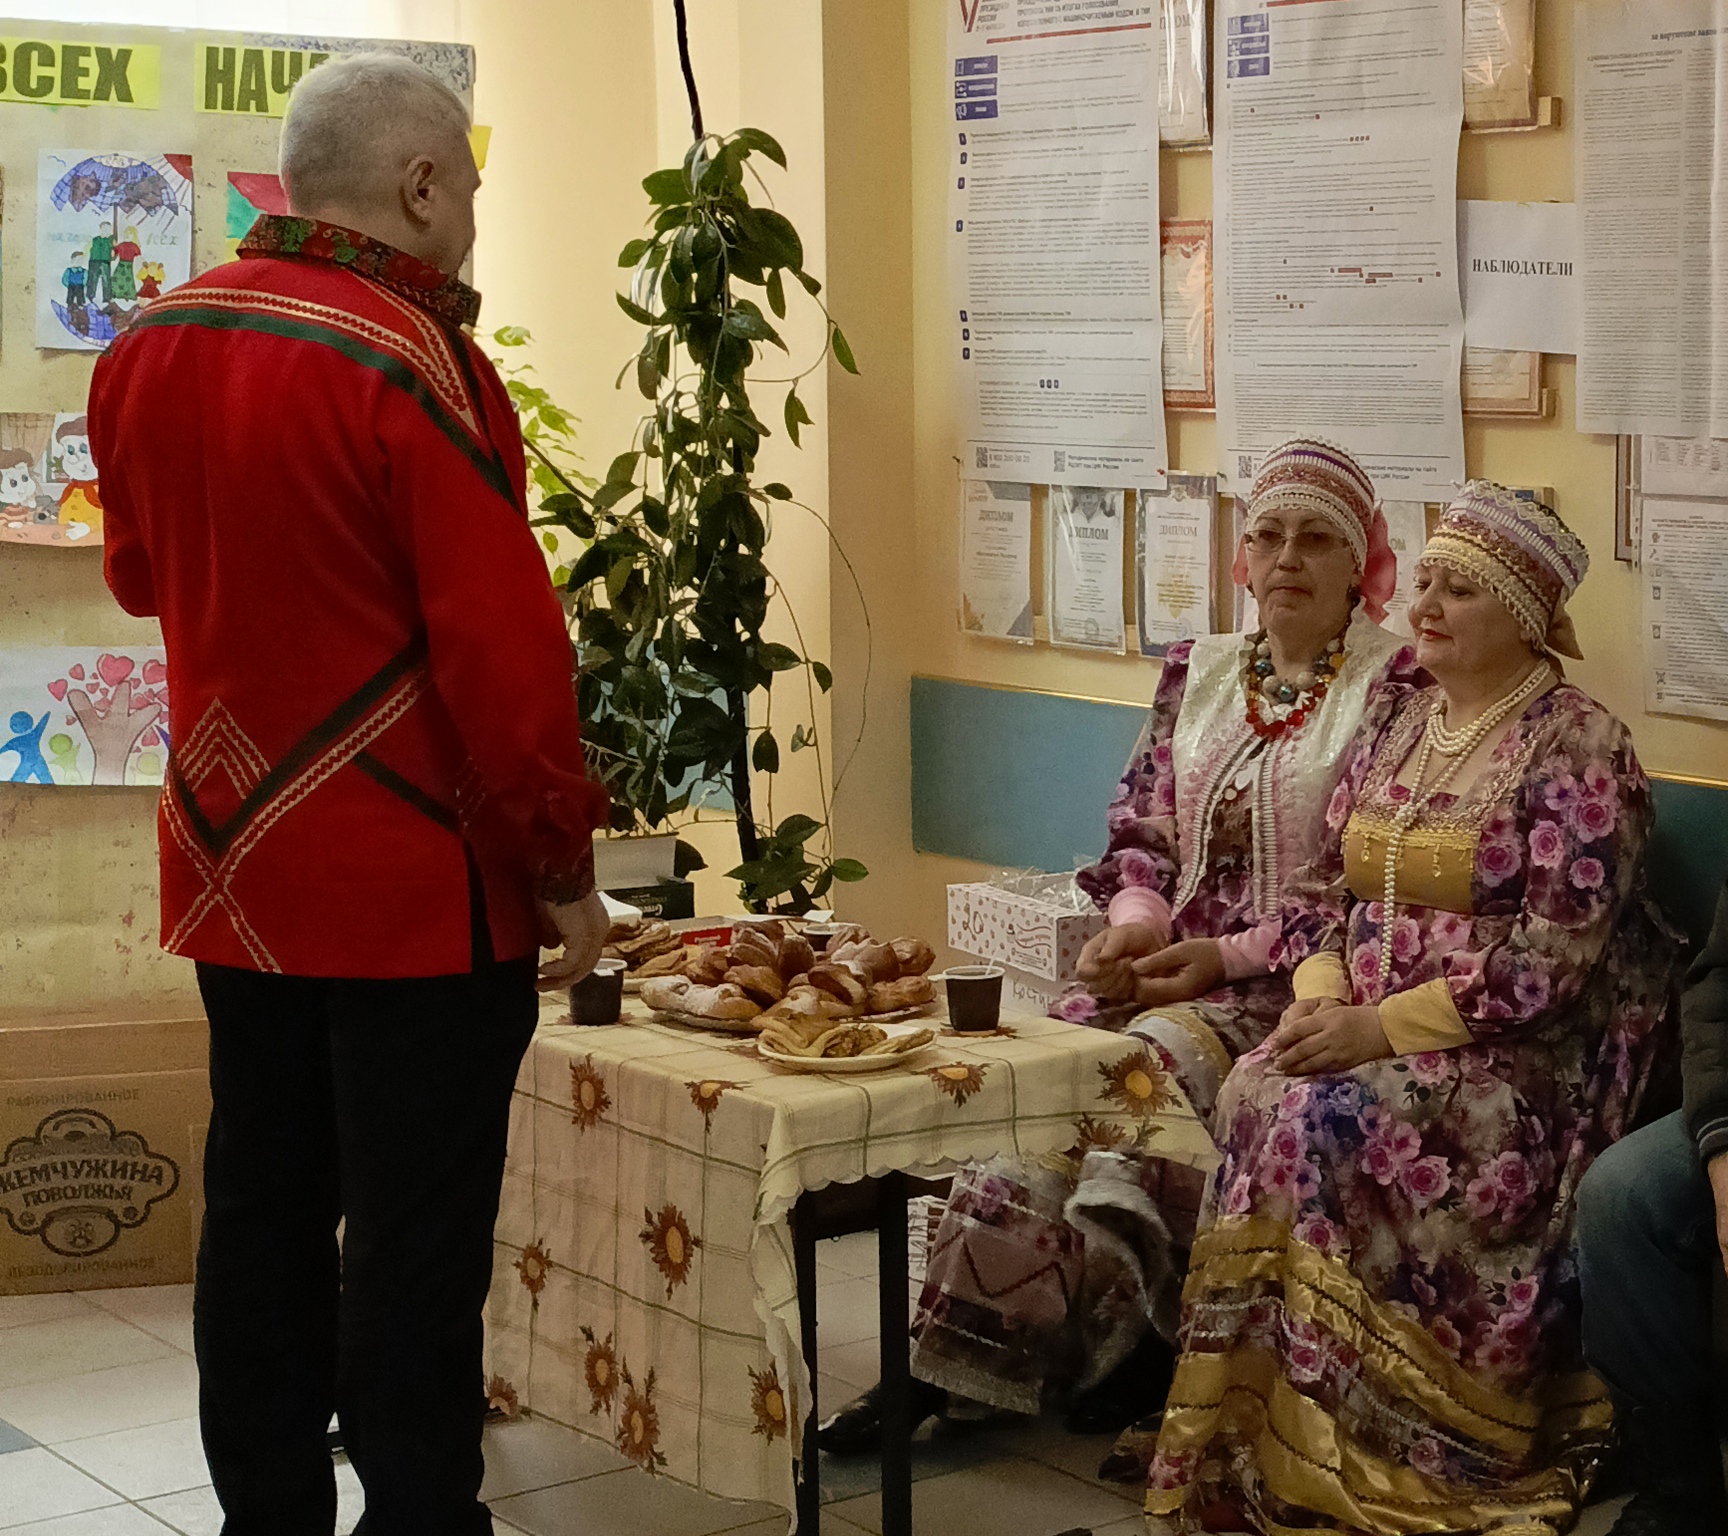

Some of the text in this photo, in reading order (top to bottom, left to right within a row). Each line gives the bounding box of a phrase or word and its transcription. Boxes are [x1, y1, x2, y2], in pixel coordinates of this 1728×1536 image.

[0, 41, 330, 113] СЕХ НАЧ
[1472, 258, 1573, 277] НАБЛЮДАТЕЛИ
[1159, 525, 1198, 538] ДИПЛОМ
